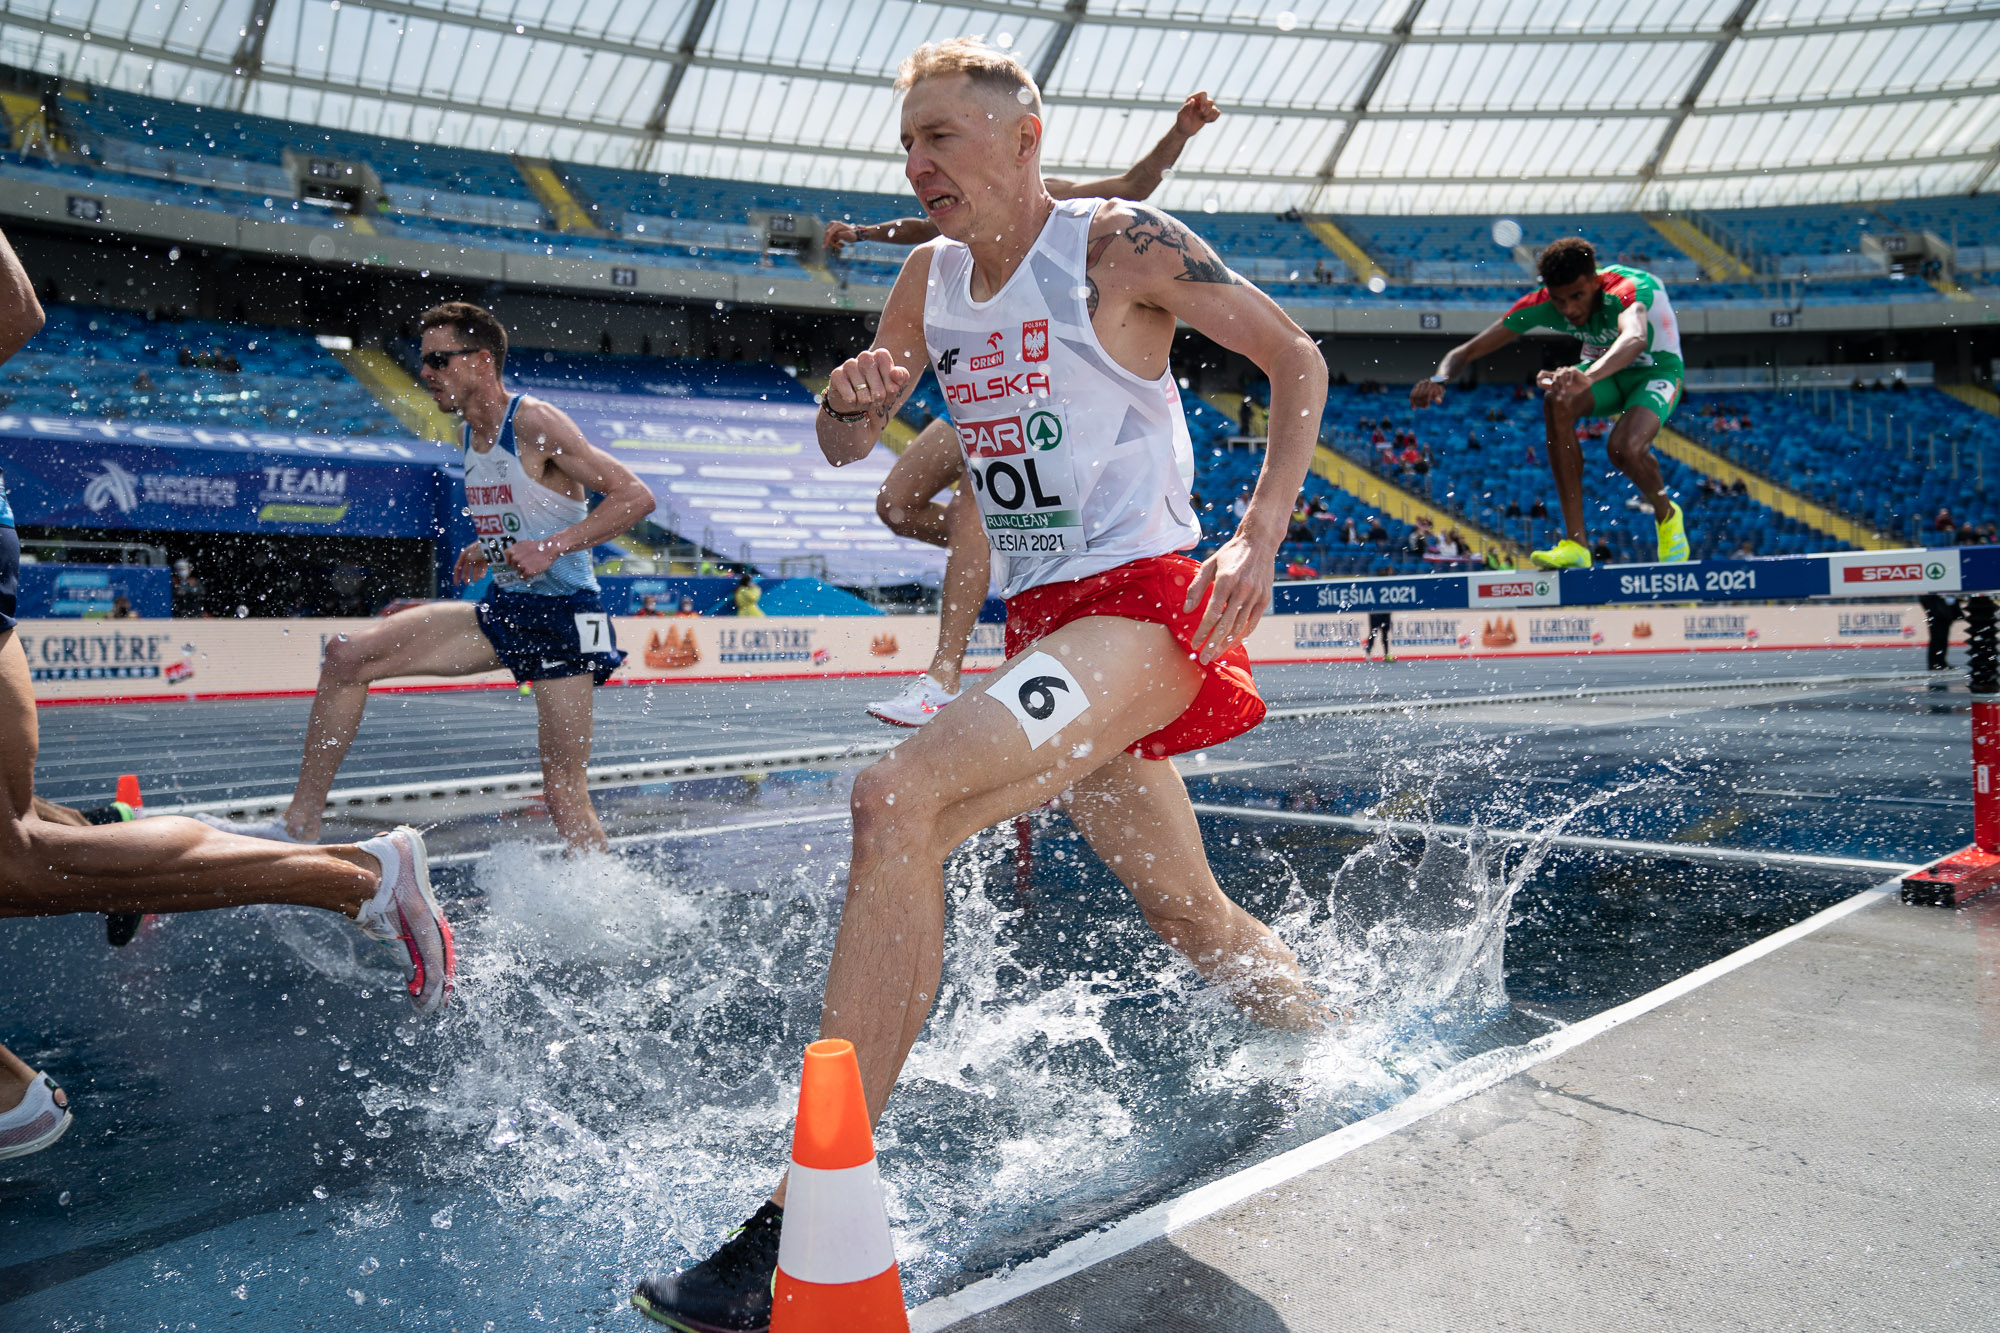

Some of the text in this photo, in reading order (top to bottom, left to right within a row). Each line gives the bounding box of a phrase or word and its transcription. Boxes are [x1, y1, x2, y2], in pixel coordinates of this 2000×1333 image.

[1024, 320, 1047, 329] POLSKA
[937, 348, 960, 374] 4F
[946, 372, 1050, 406] POLSKA
[960, 422, 1022, 453] PAR
[262, 466, 347, 494] TEAM
[474, 518, 501, 533] PAR
[1031, 533, 1066, 551] 2021
[1620, 570, 1757, 594] SILESIA 2021
[1862, 566, 1922, 581] SPAR
[1318, 584, 1416, 606] SILESIA 2021
[1490, 584, 1533, 597] SPAR
[587, 620, 600, 646] 7
[42, 630, 161, 665] GRUYÈRE
[1018, 675, 1070, 720] 6
